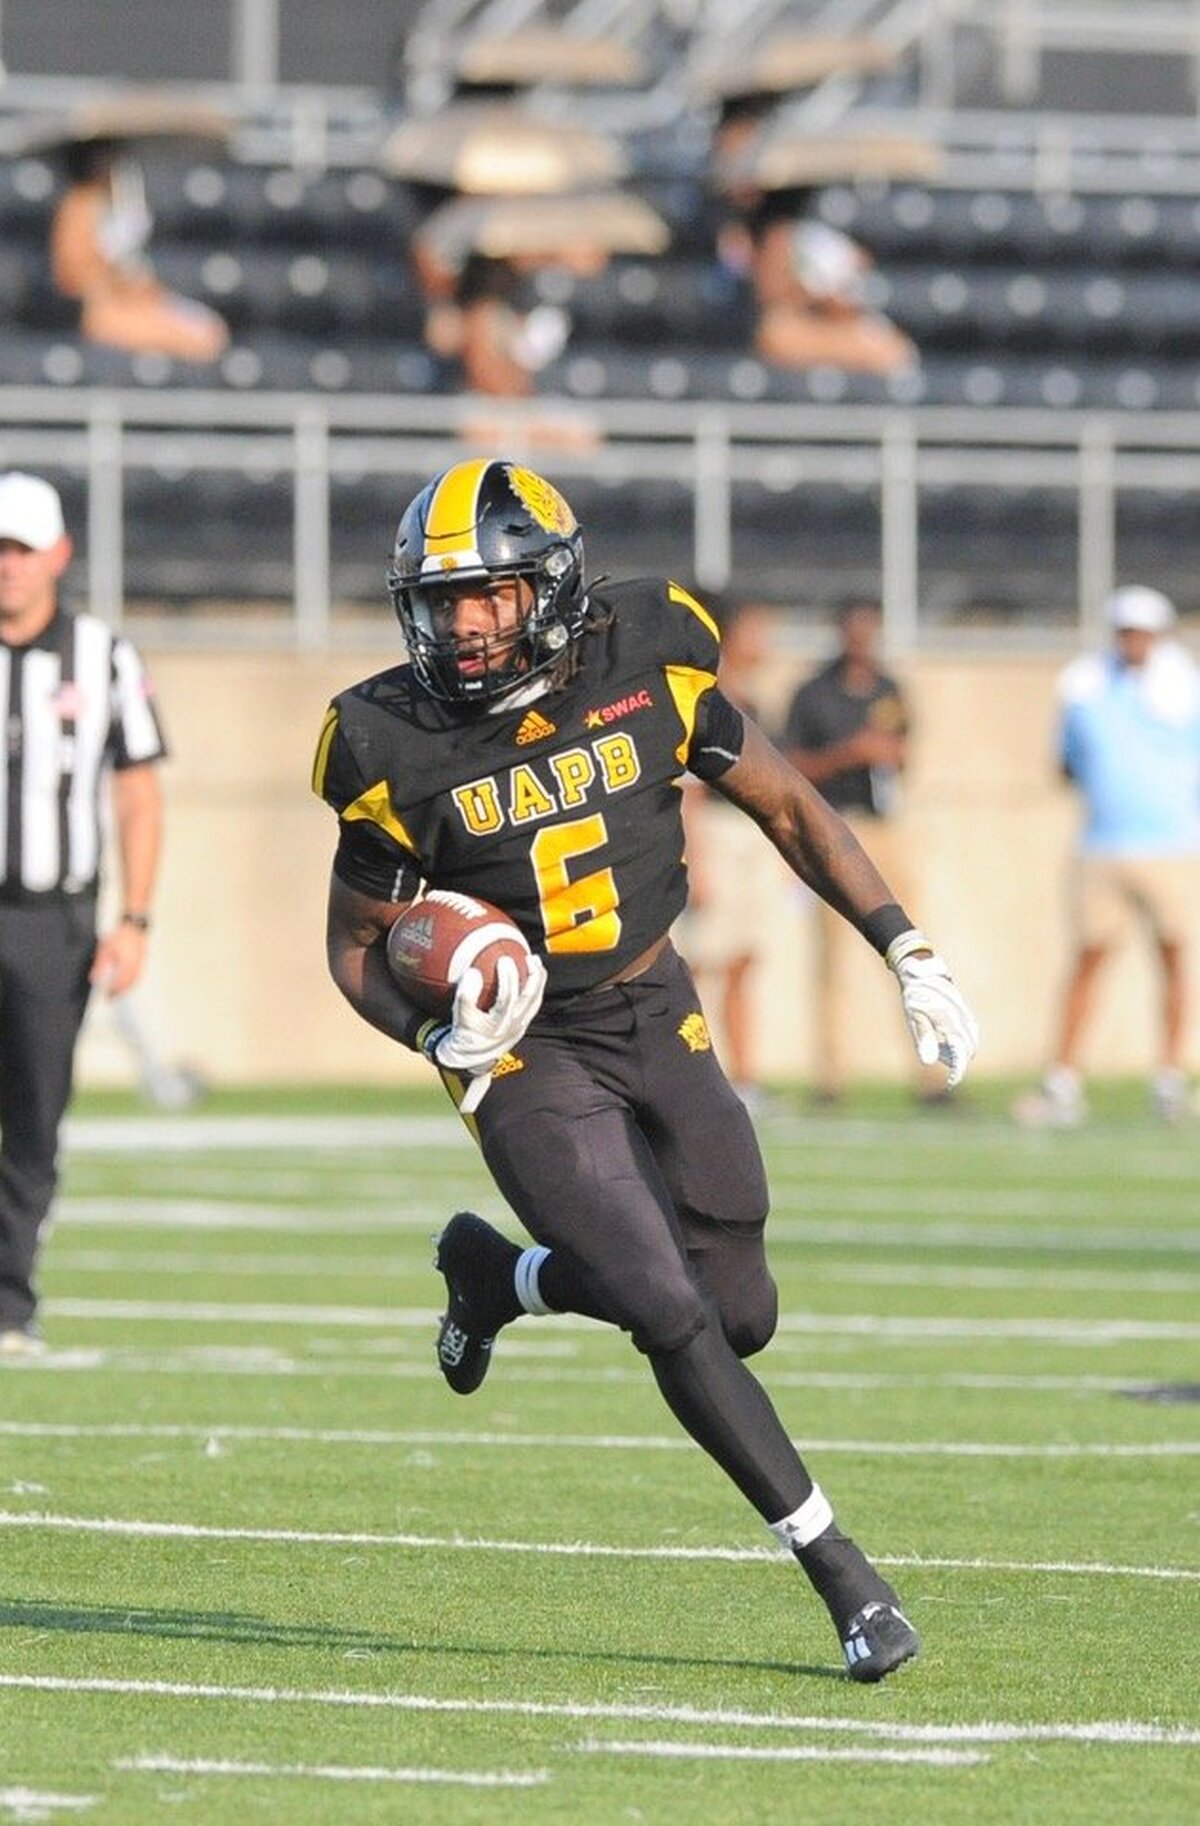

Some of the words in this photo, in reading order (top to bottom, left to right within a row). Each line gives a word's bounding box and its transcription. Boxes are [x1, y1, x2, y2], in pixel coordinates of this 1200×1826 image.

[602, 690, 653, 722] SWAC
[451, 731, 642, 837] UAPB
[529, 811, 623, 955] 6
